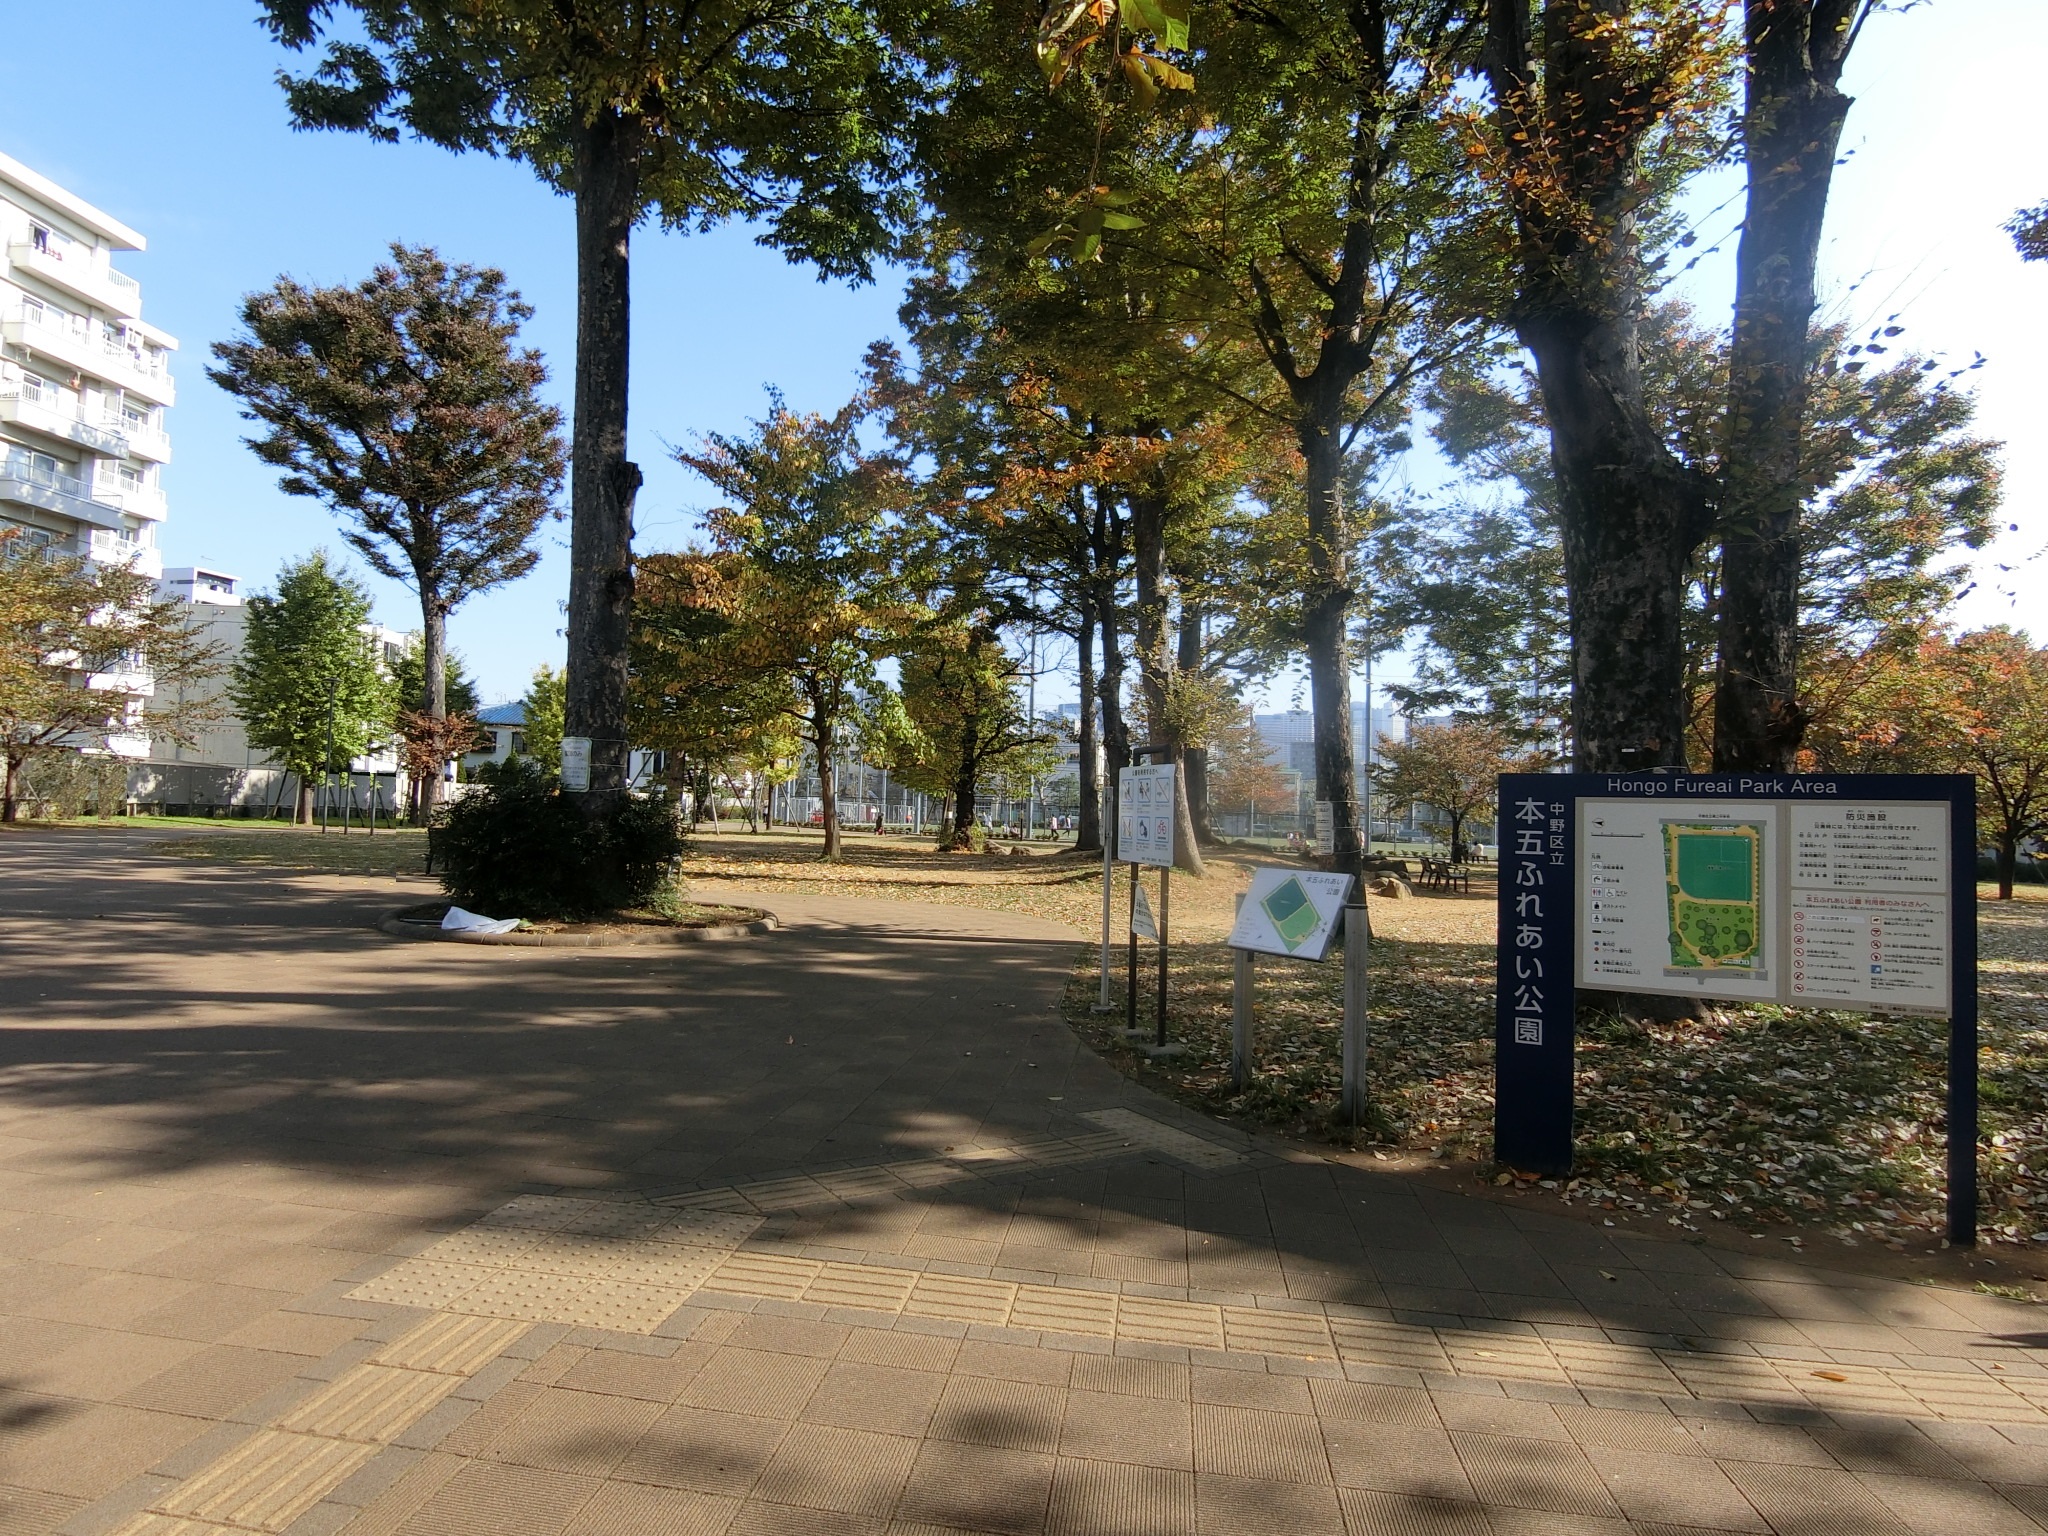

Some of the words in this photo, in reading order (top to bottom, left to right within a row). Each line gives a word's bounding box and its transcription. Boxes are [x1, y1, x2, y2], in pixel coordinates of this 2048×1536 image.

[1607, 779, 1667, 795] Hongo
[1674, 779, 1732, 793] Fureai
[1739, 779, 1784, 794] Park
[1790, 779, 1838, 794] Area
[1549, 802, 1565, 866] 中野区立
[1514, 797, 1545, 1046] 本五ふれあい公園
